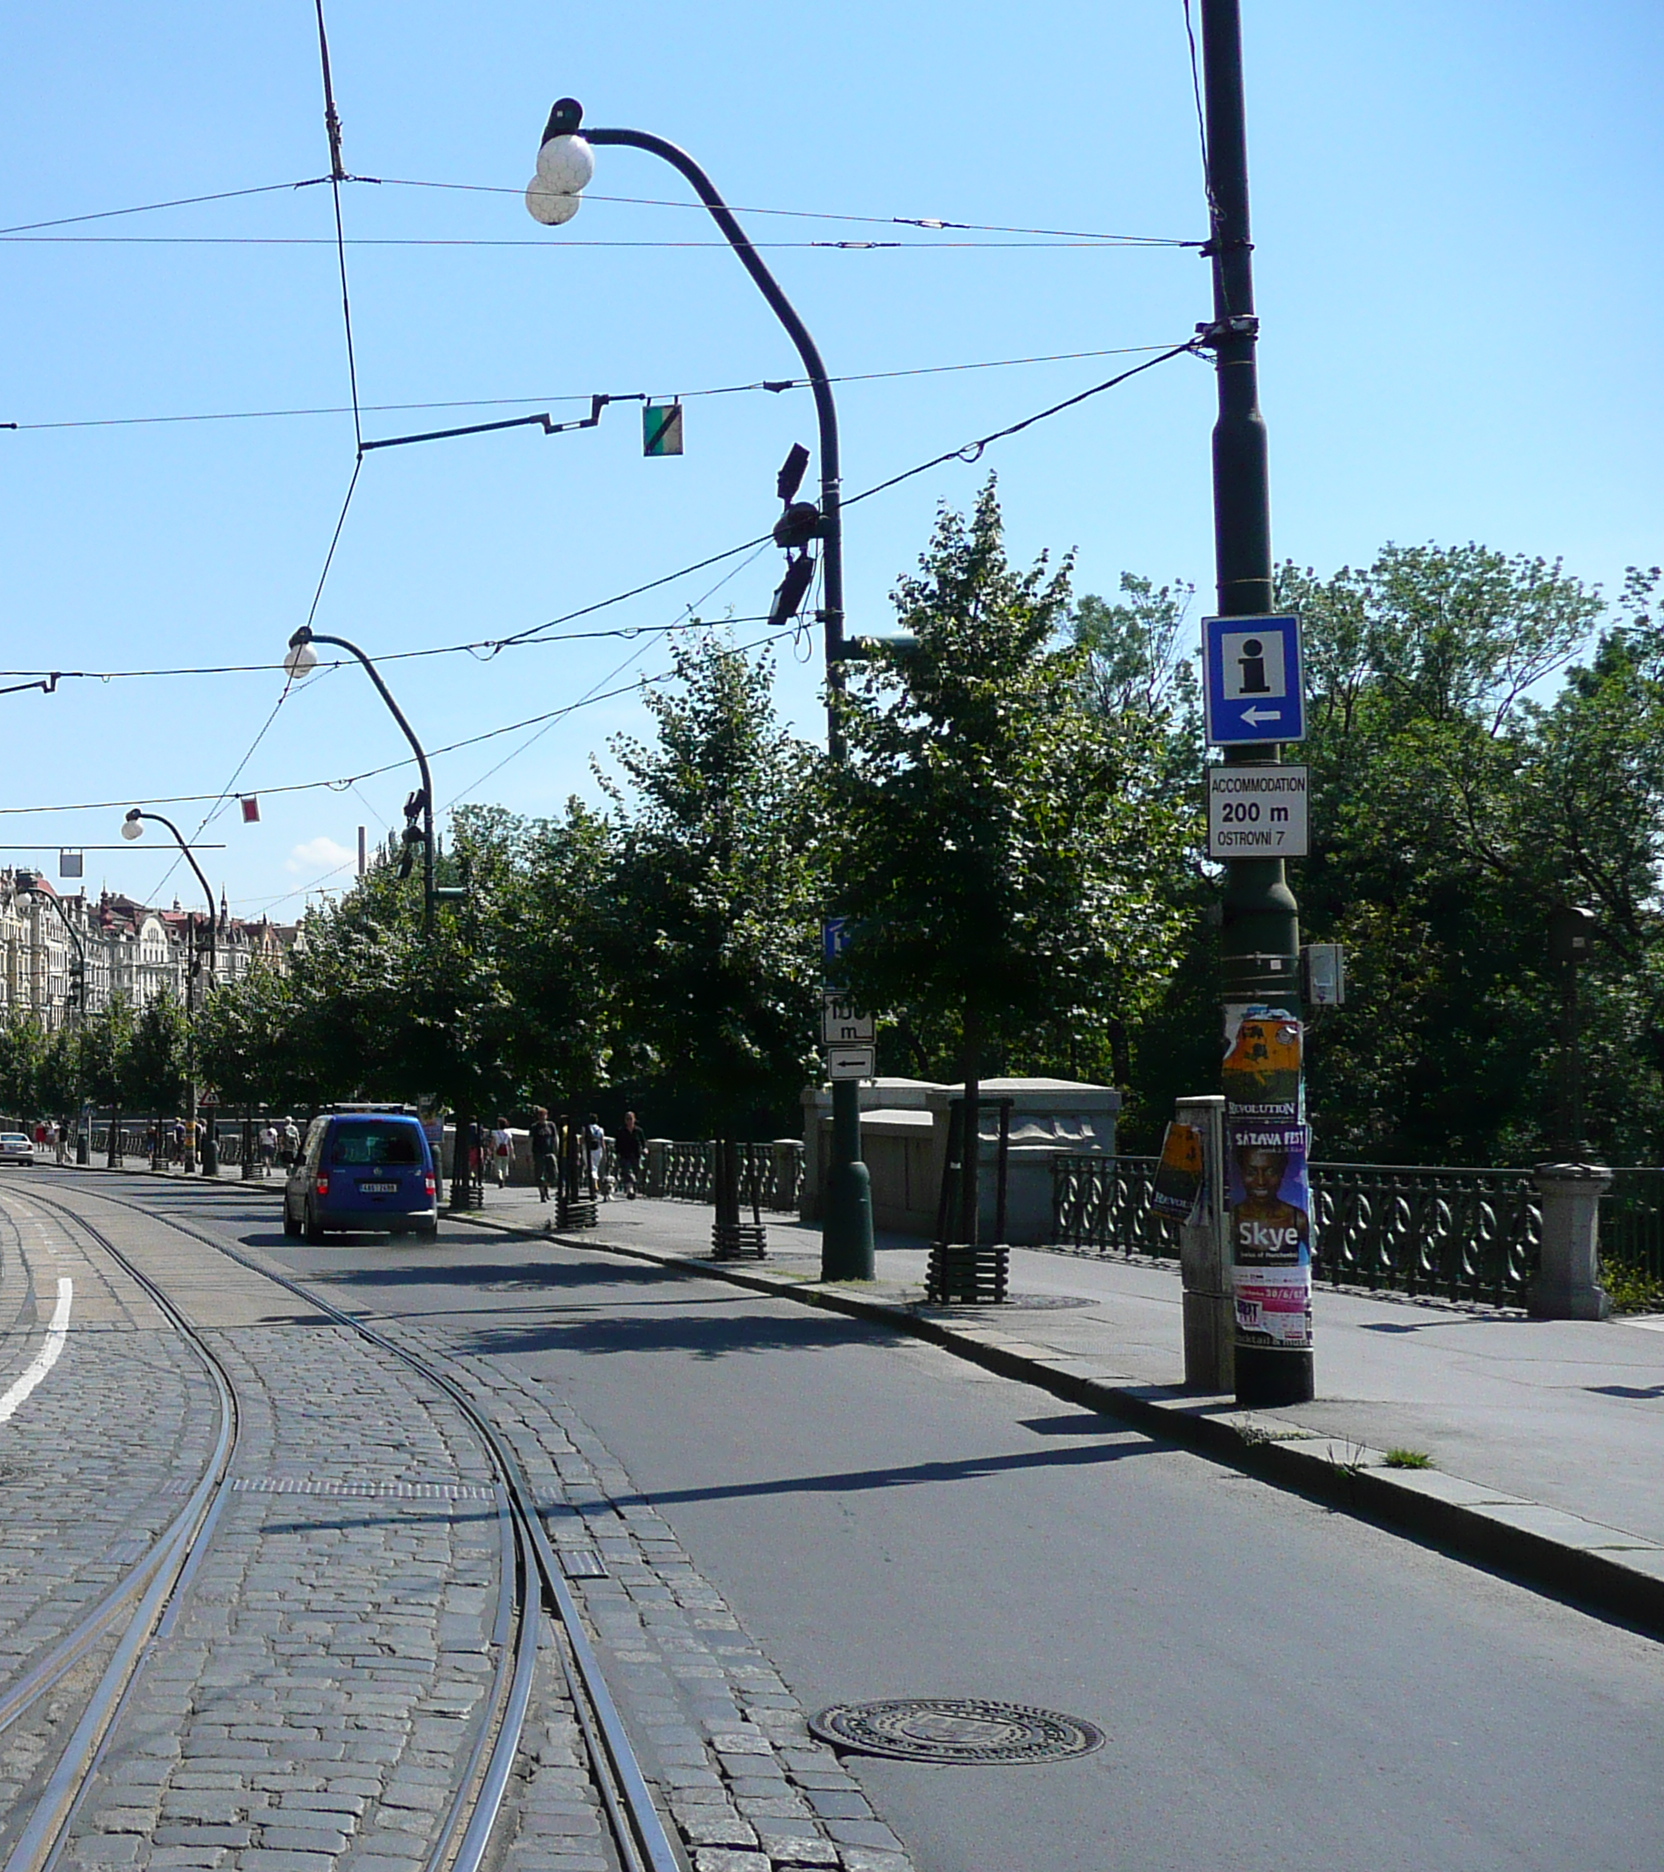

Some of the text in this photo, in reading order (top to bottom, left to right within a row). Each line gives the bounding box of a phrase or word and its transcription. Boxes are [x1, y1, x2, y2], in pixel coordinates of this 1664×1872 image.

[1212, 777, 1305, 793] ACCOMMODATION
[1222, 802, 1289, 823] 200 m
[1217, 828, 1285, 846] OSTROVNÍ 7
[841, 1026, 857, 1039] m
[1228, 1101, 1295, 1115] REVOLUTION
[1239, 1221, 1298, 1252] Skye
